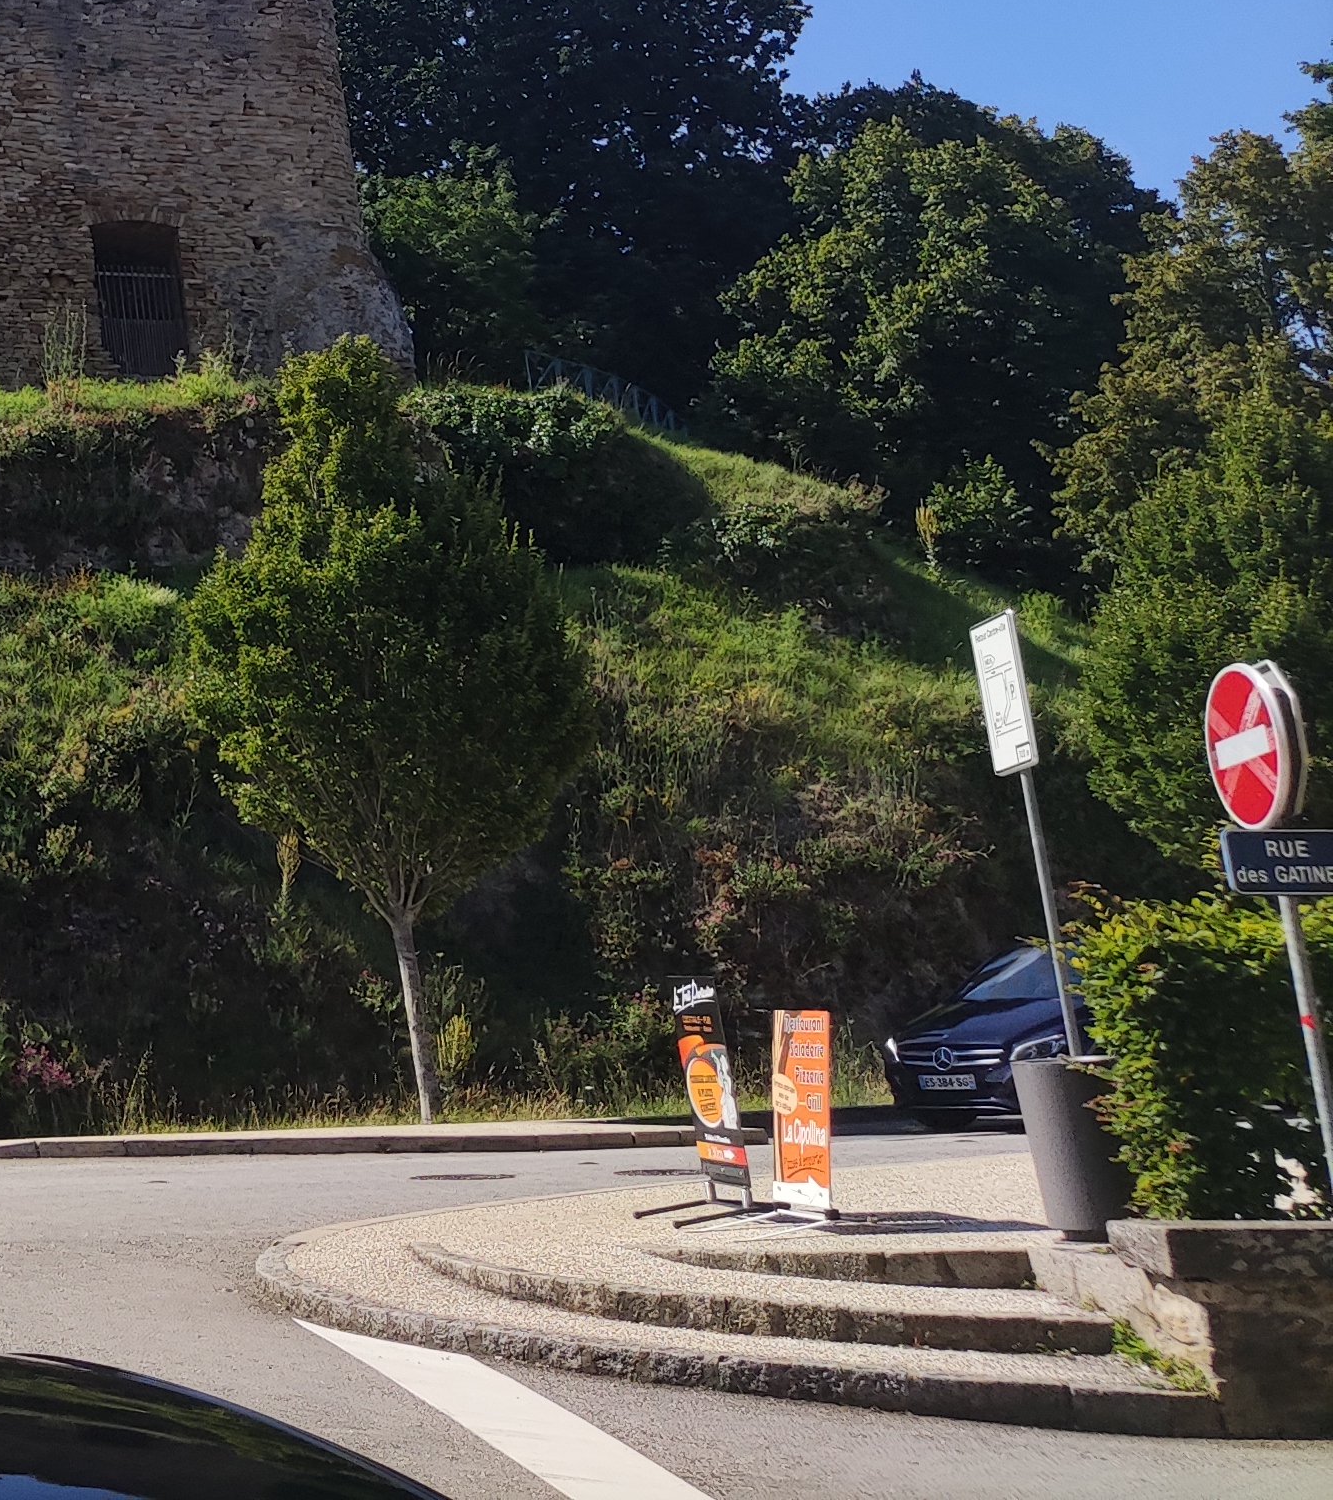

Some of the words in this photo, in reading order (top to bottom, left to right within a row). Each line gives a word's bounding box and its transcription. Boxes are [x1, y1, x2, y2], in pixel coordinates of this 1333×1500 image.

[1264, 840, 1311, 858] RUE
[1236, 865, 1270, 883] des
[783, 1013, 824, 1033] Restaurant
[789, 1040, 824, 1058] Saladerie
[795, 1066, 824, 1085] Pizzeria
[805, 1092, 823, 1111] Grill
[783, 1117, 793, 1143] La
[793, 1118, 826, 1153] Cipollina
